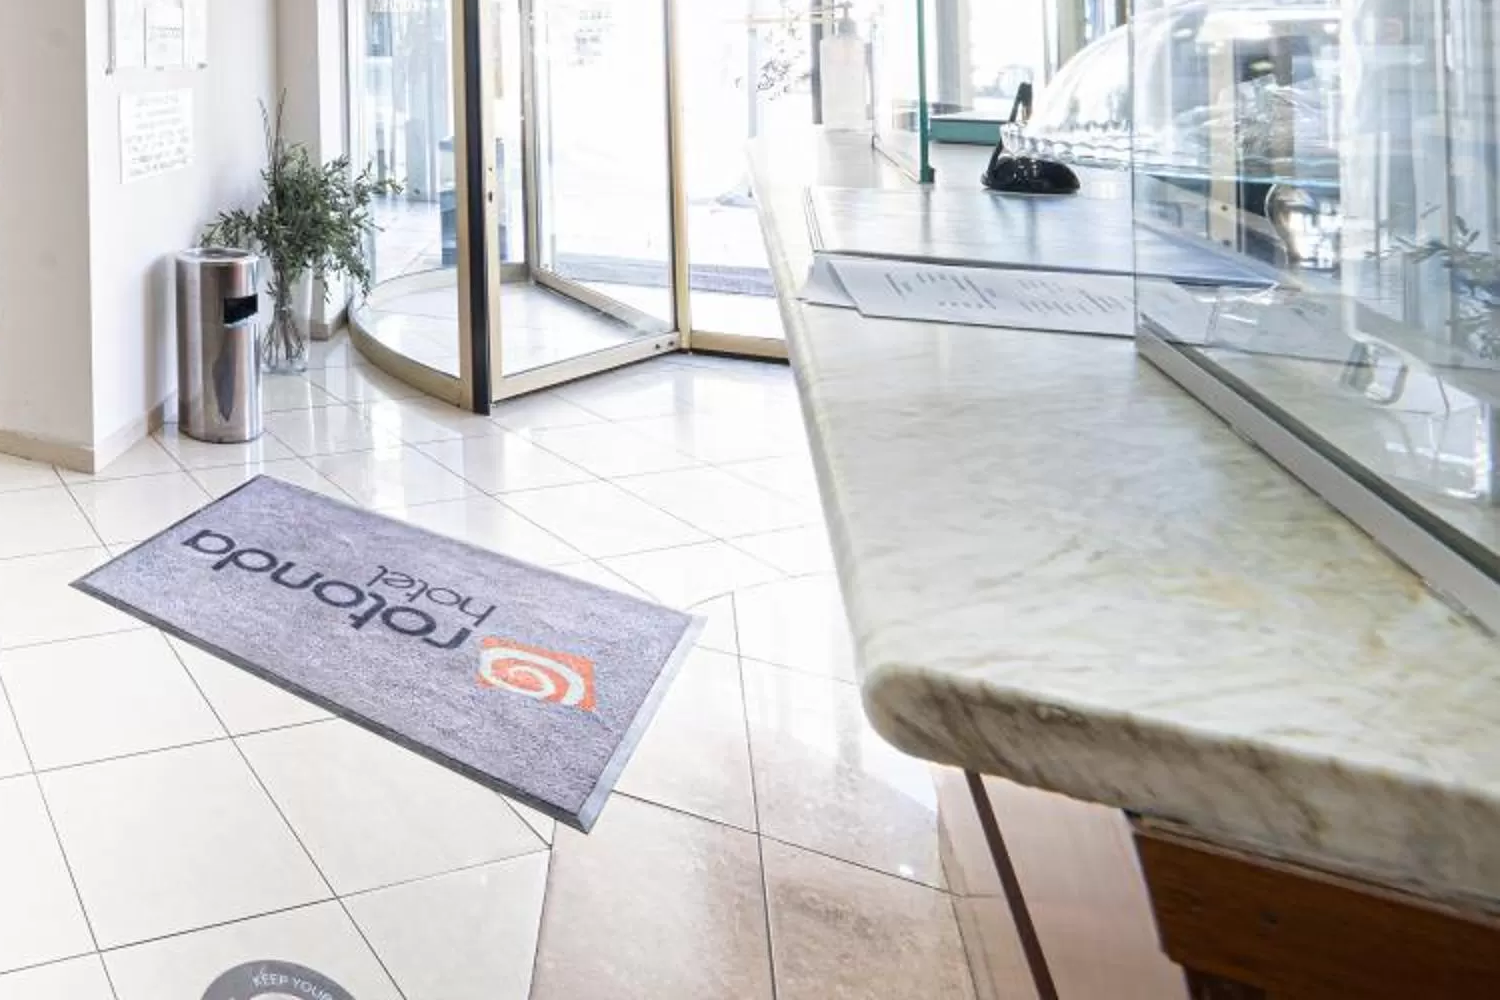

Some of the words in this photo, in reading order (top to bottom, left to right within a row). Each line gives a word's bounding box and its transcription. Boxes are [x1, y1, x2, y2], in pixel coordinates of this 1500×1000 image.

[182, 529, 473, 649] rotonda
[366, 565, 497, 627] hotel
[251, 973, 288, 988] KEEP
